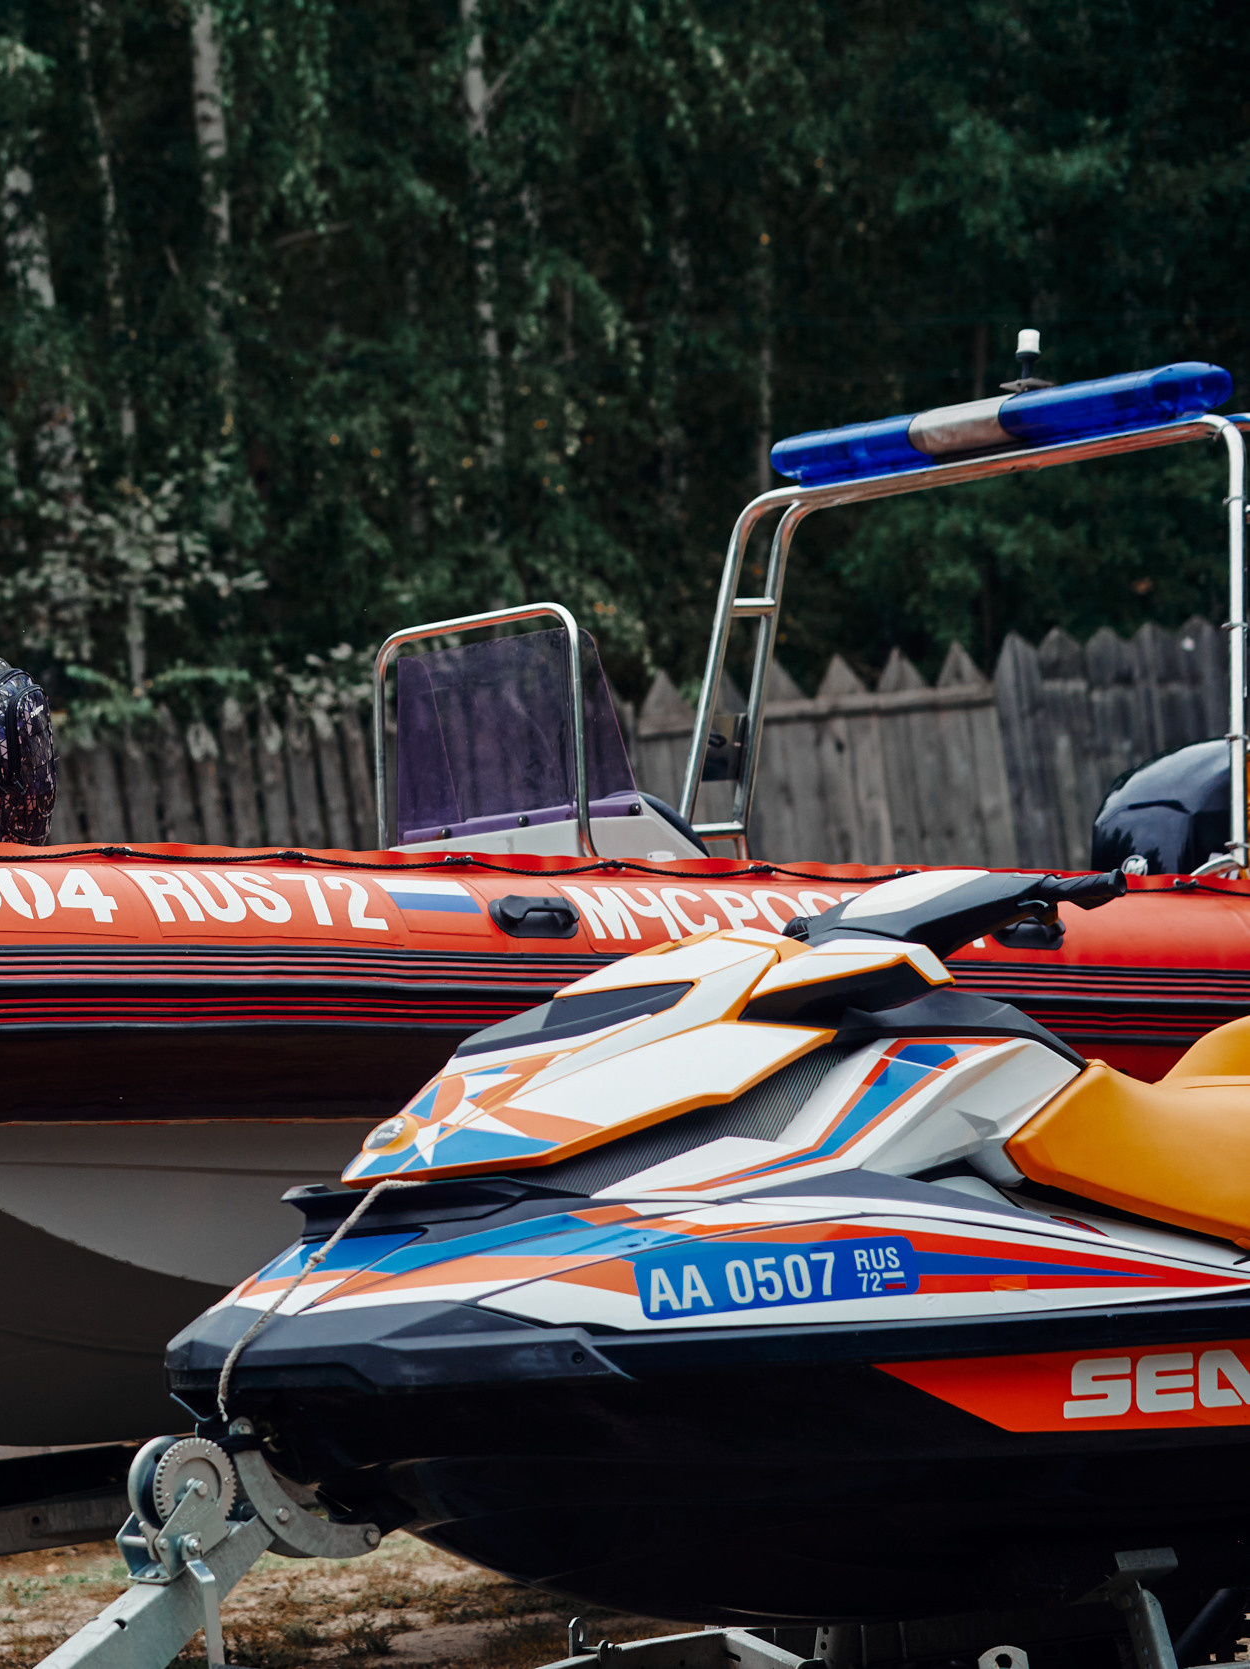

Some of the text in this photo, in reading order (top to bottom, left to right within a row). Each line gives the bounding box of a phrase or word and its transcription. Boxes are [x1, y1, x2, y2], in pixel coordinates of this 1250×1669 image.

[143, 869, 292, 924] RUS
[272, 873, 389, 931] 72
[561, 885, 719, 939] МЧС
[649, 1251, 836, 1313] AA 0507
[853, 1246, 901, 1271] RUS
[857, 1271, 883, 1293] 72
[1063, 1349, 1250, 1419] SEA
